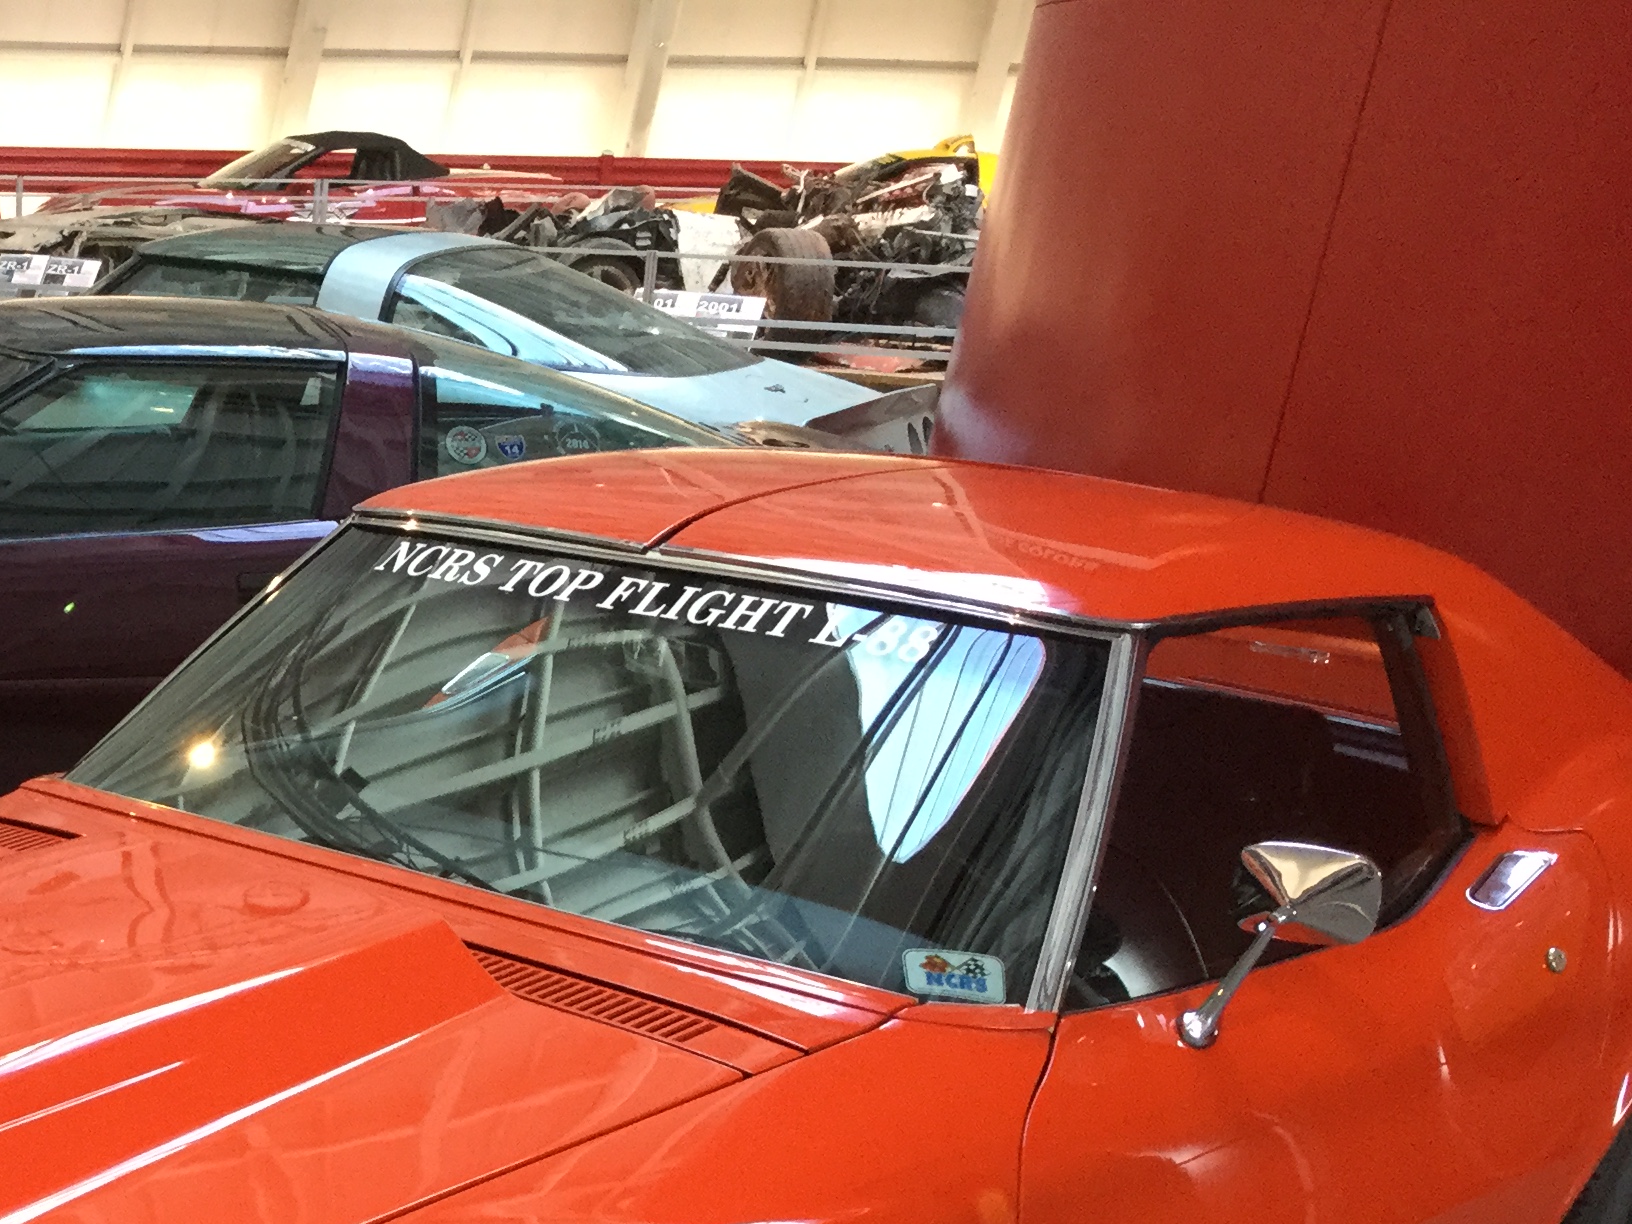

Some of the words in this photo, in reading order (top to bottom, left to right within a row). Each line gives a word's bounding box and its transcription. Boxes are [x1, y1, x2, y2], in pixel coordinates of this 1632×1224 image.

[45, 263, 80, 275] ZR-1
[697, 300, 738, 314] 2001
[374, 541, 500, 586] NCRS
[502, 558, 601, 603] TOP
[596, 575, 814, 638] FLIGHT
[808, 602, 939, 663] L-88
[924, 970, 989, 993] NCRS
